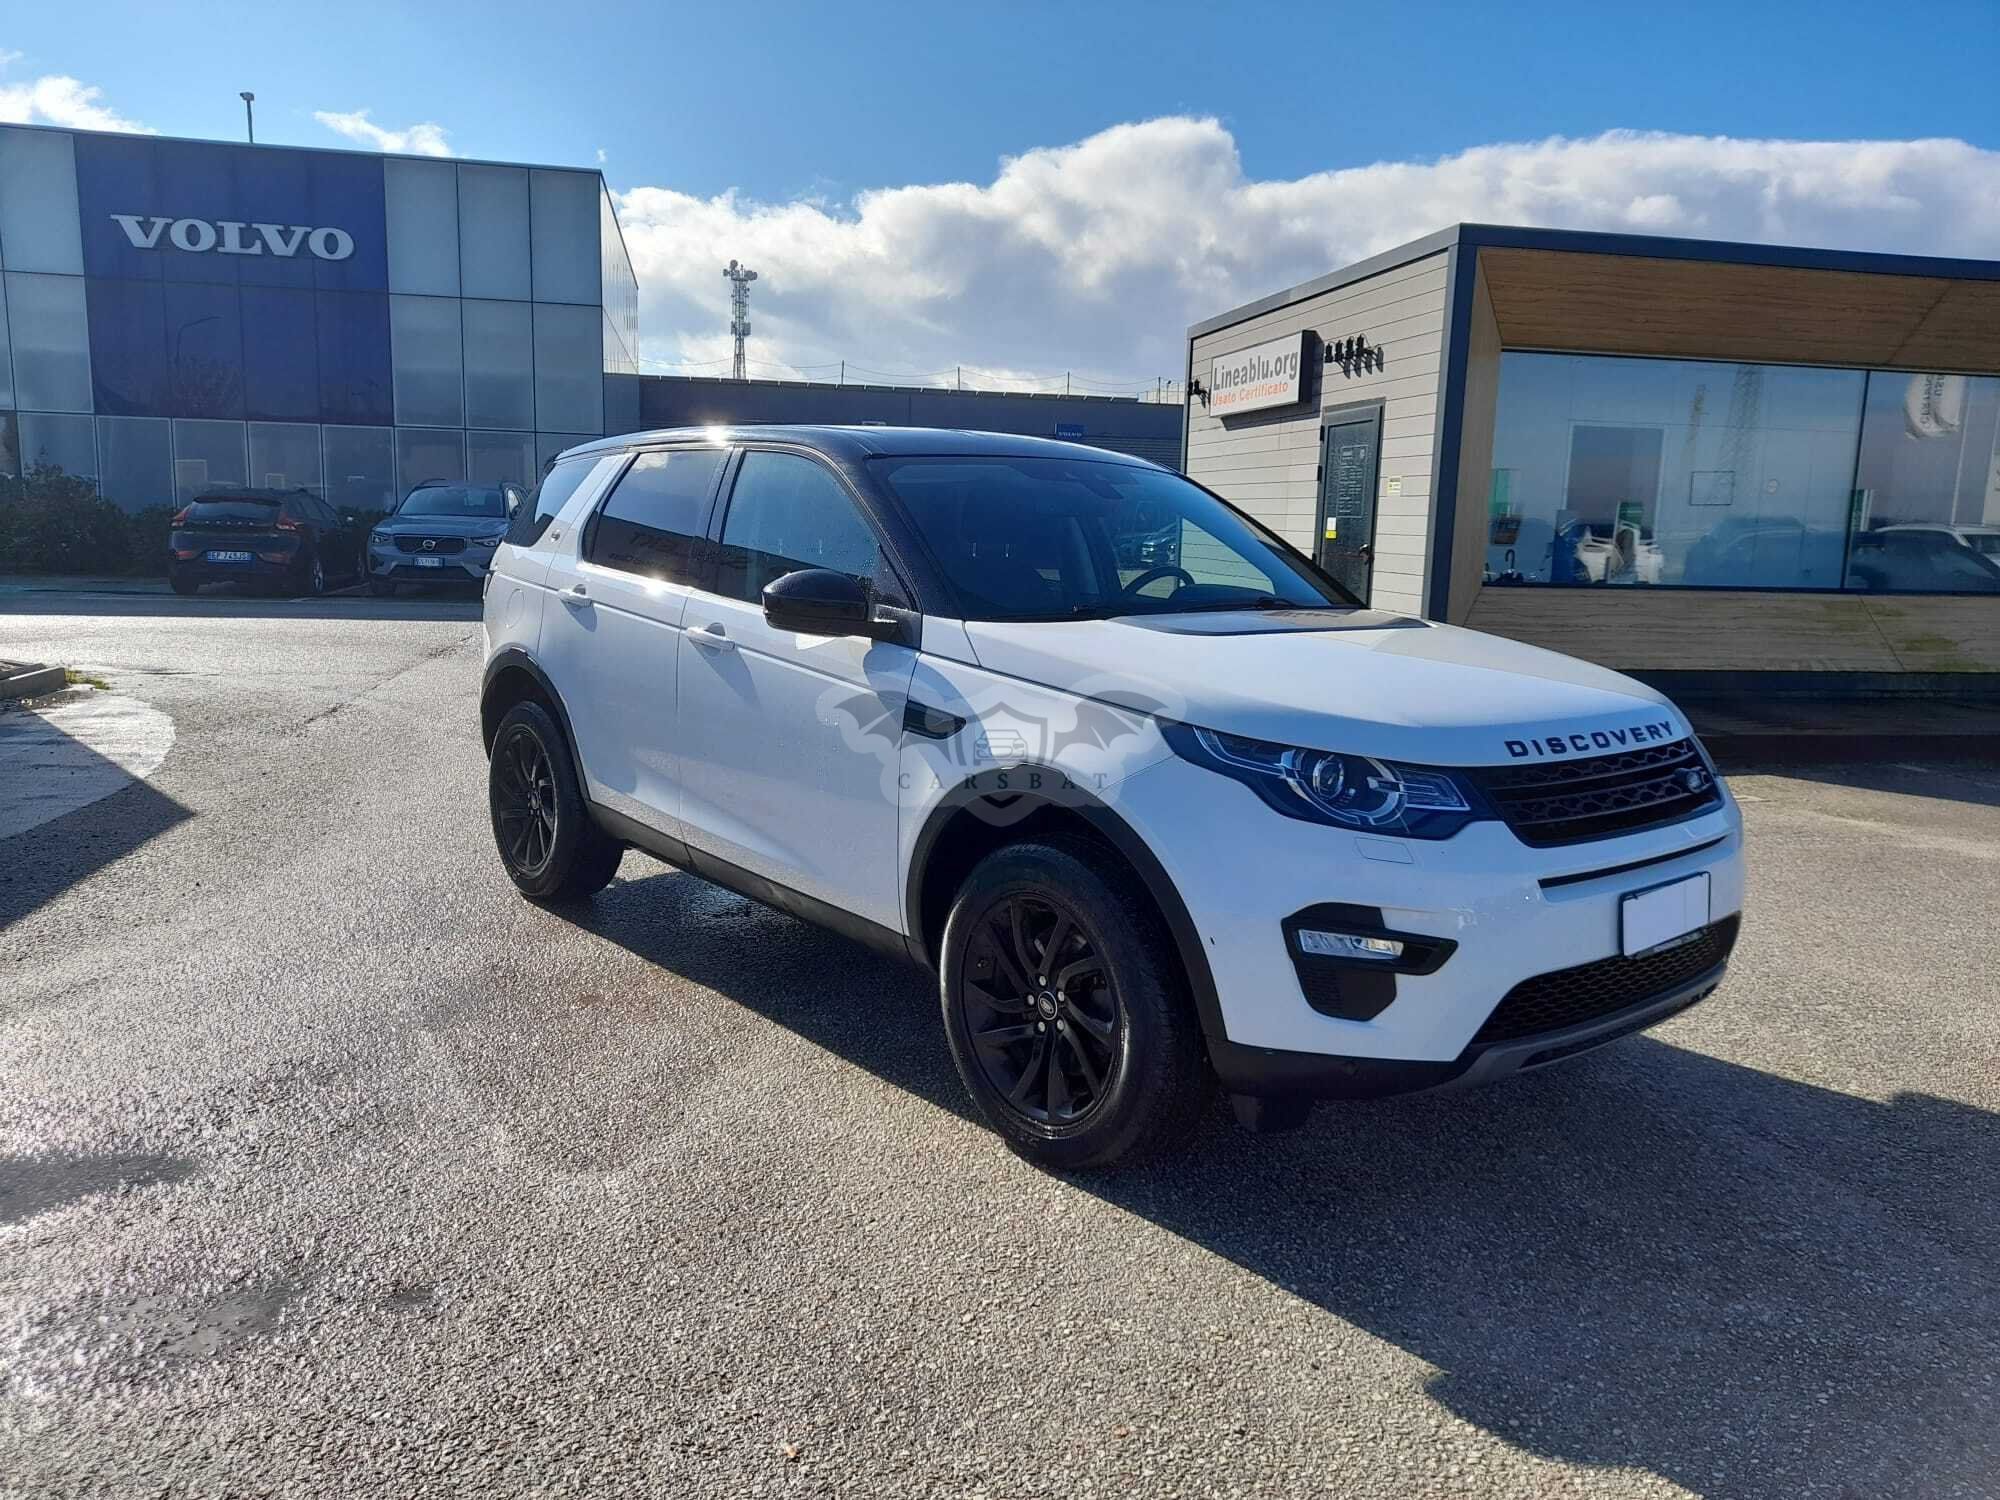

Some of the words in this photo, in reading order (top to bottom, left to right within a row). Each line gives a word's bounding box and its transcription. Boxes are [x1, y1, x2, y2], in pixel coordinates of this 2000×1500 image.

[111, 214, 355, 261] VOLVO
[1213, 351, 1298, 391] Lineablu.org
[1214, 391, 1236, 406] Usato
[1239, 381, 1289, 402] Certificato
[1504, 721, 1674, 758] DISCOVERY
